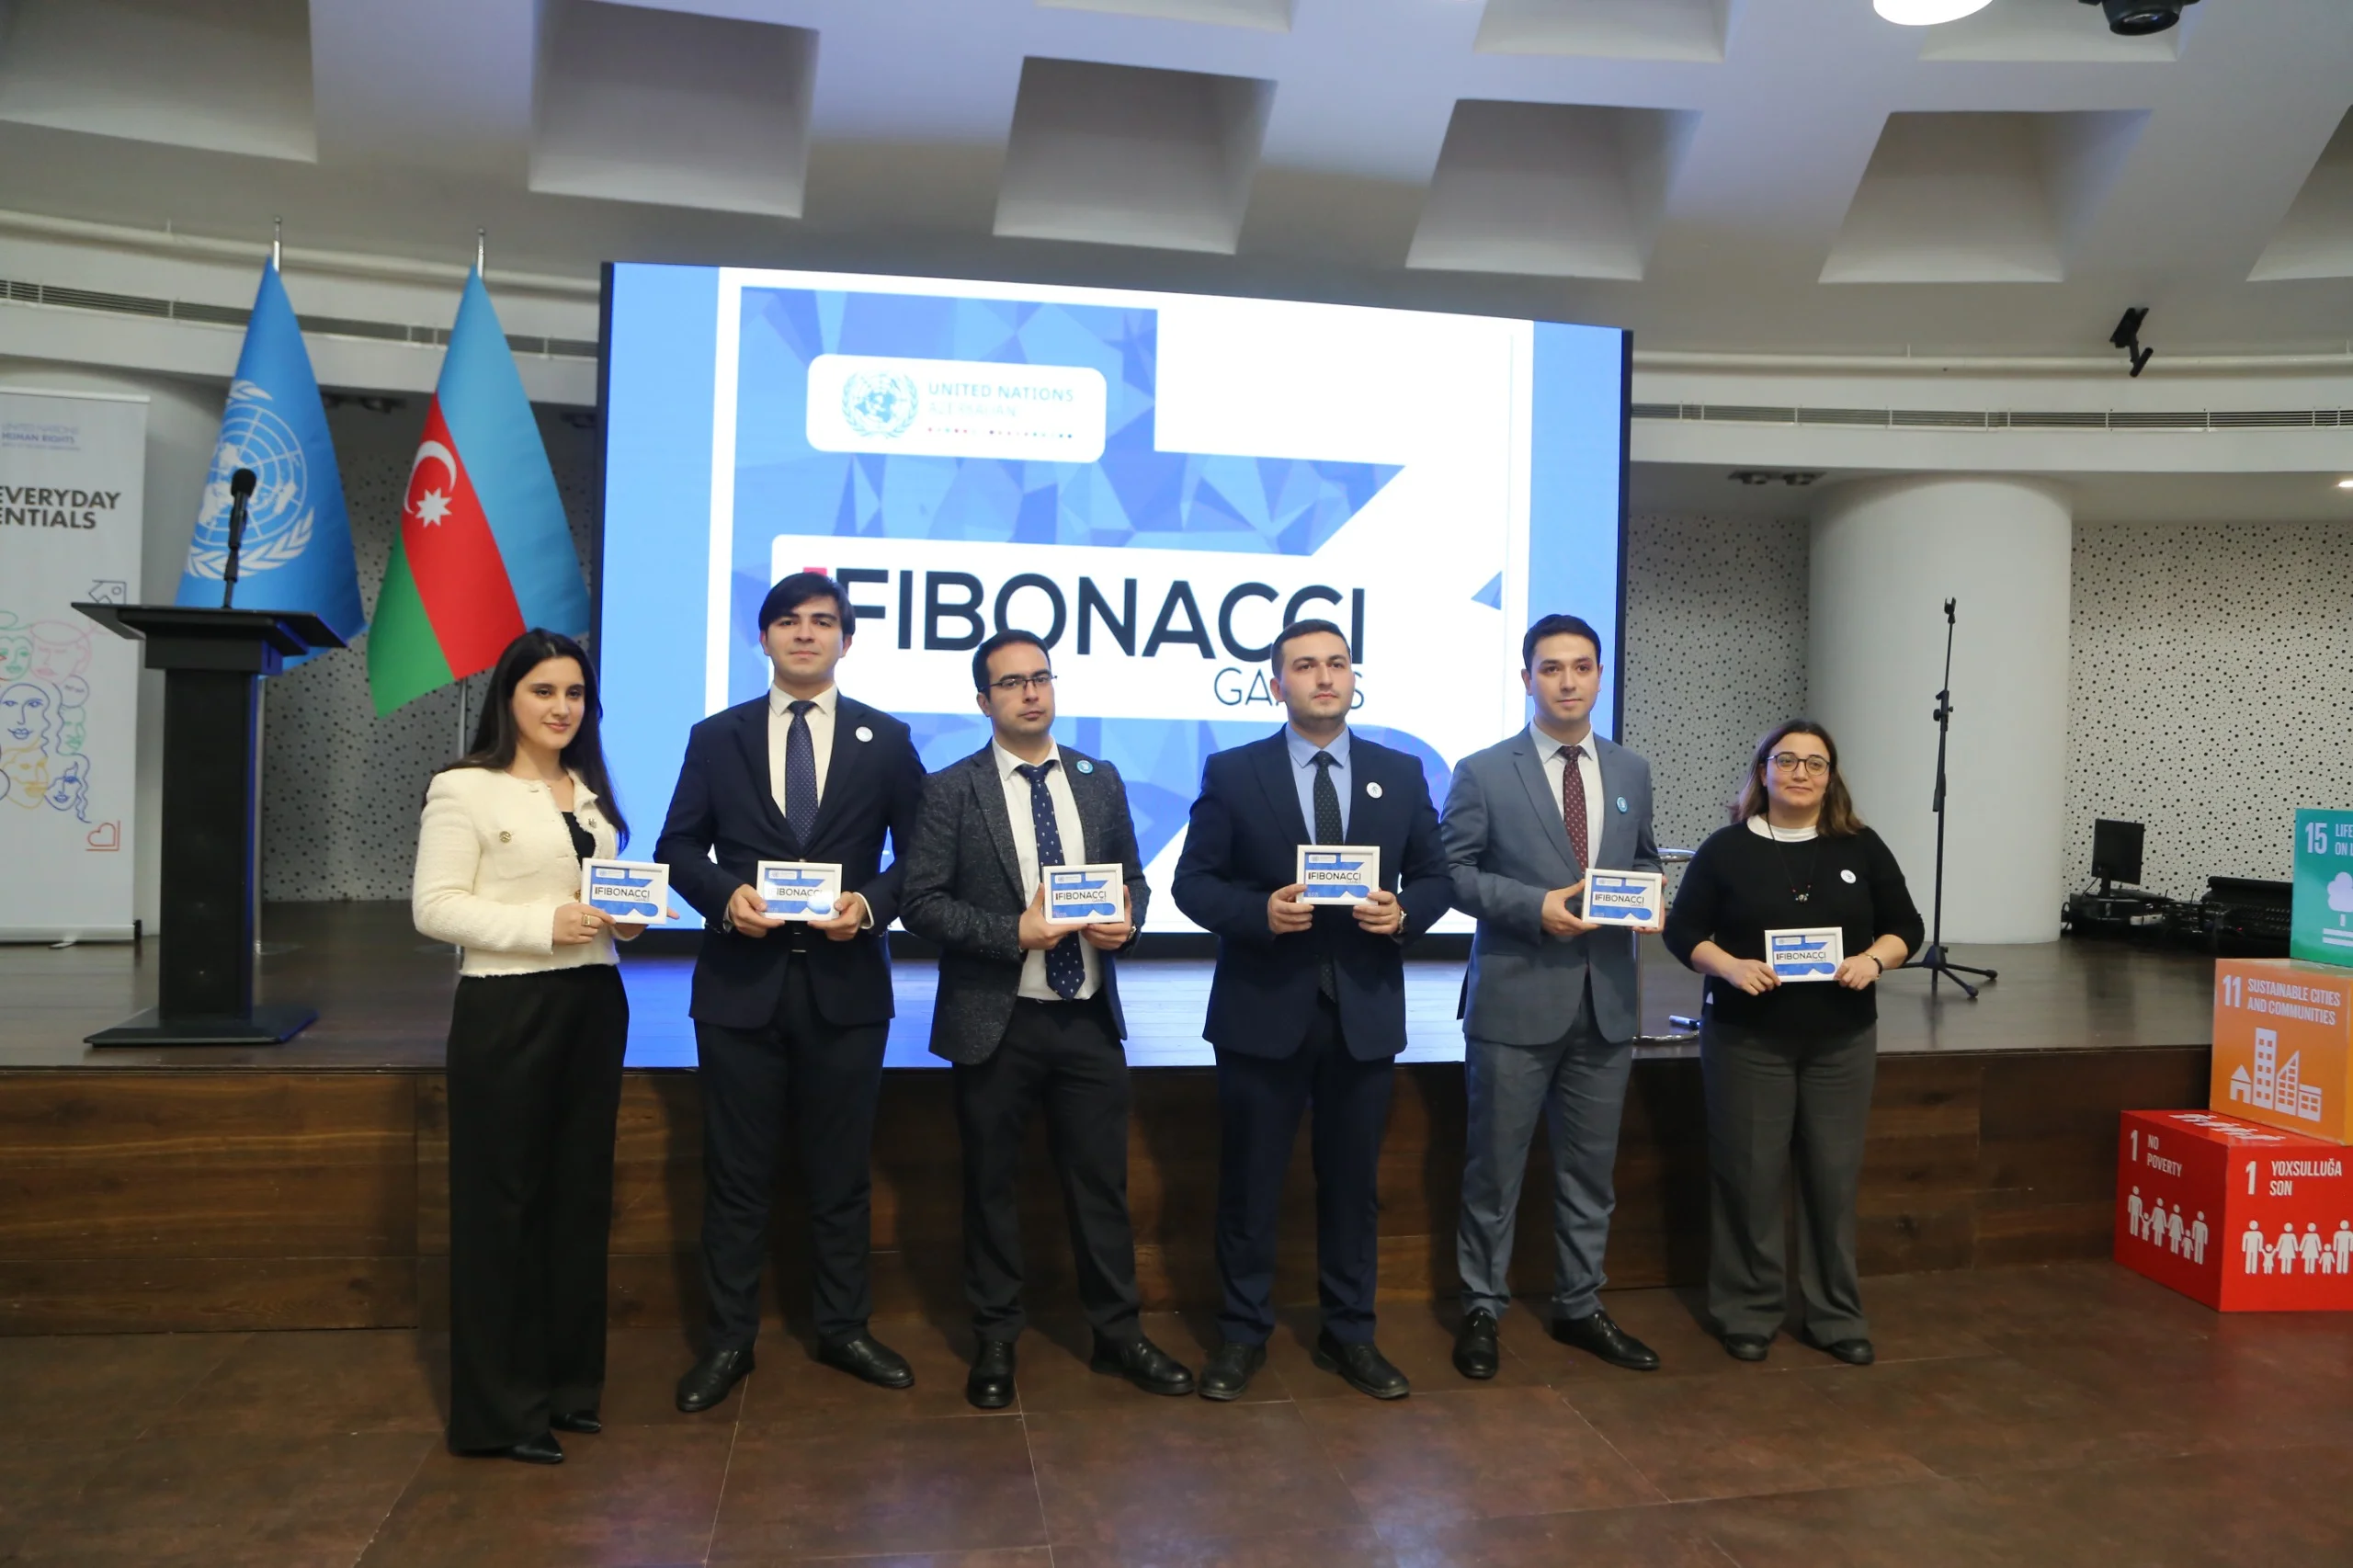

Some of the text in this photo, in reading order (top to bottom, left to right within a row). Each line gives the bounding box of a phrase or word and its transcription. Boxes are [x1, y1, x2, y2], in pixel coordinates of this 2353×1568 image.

[928, 381, 1074, 403] UNITED NATIONS
[0, 507, 97, 529] NTIALS
[1214, 667, 1364, 710] GAS
[2305, 822, 2327, 855] 15
[2336, 824, 2353, 837] LIFE
[2336, 842, 2347, 856] ON
[2222, 975, 2241, 1007] 11
[2247, 978, 2341, 1006] SUSTAINABLE CITIES
[2247, 997, 2336, 1025] AND COMMUNITIES
[2131, 1130, 2139, 1161] 1
[2148, 1134, 2159, 1150] NO
[2147, 1153, 2182, 1177] POVERTY
[2271, 1158, 2342, 1176] YOXSULLUĞA
[2245, 1161, 2256, 1195] 1
[2269, 1180, 2292, 1196] SON
